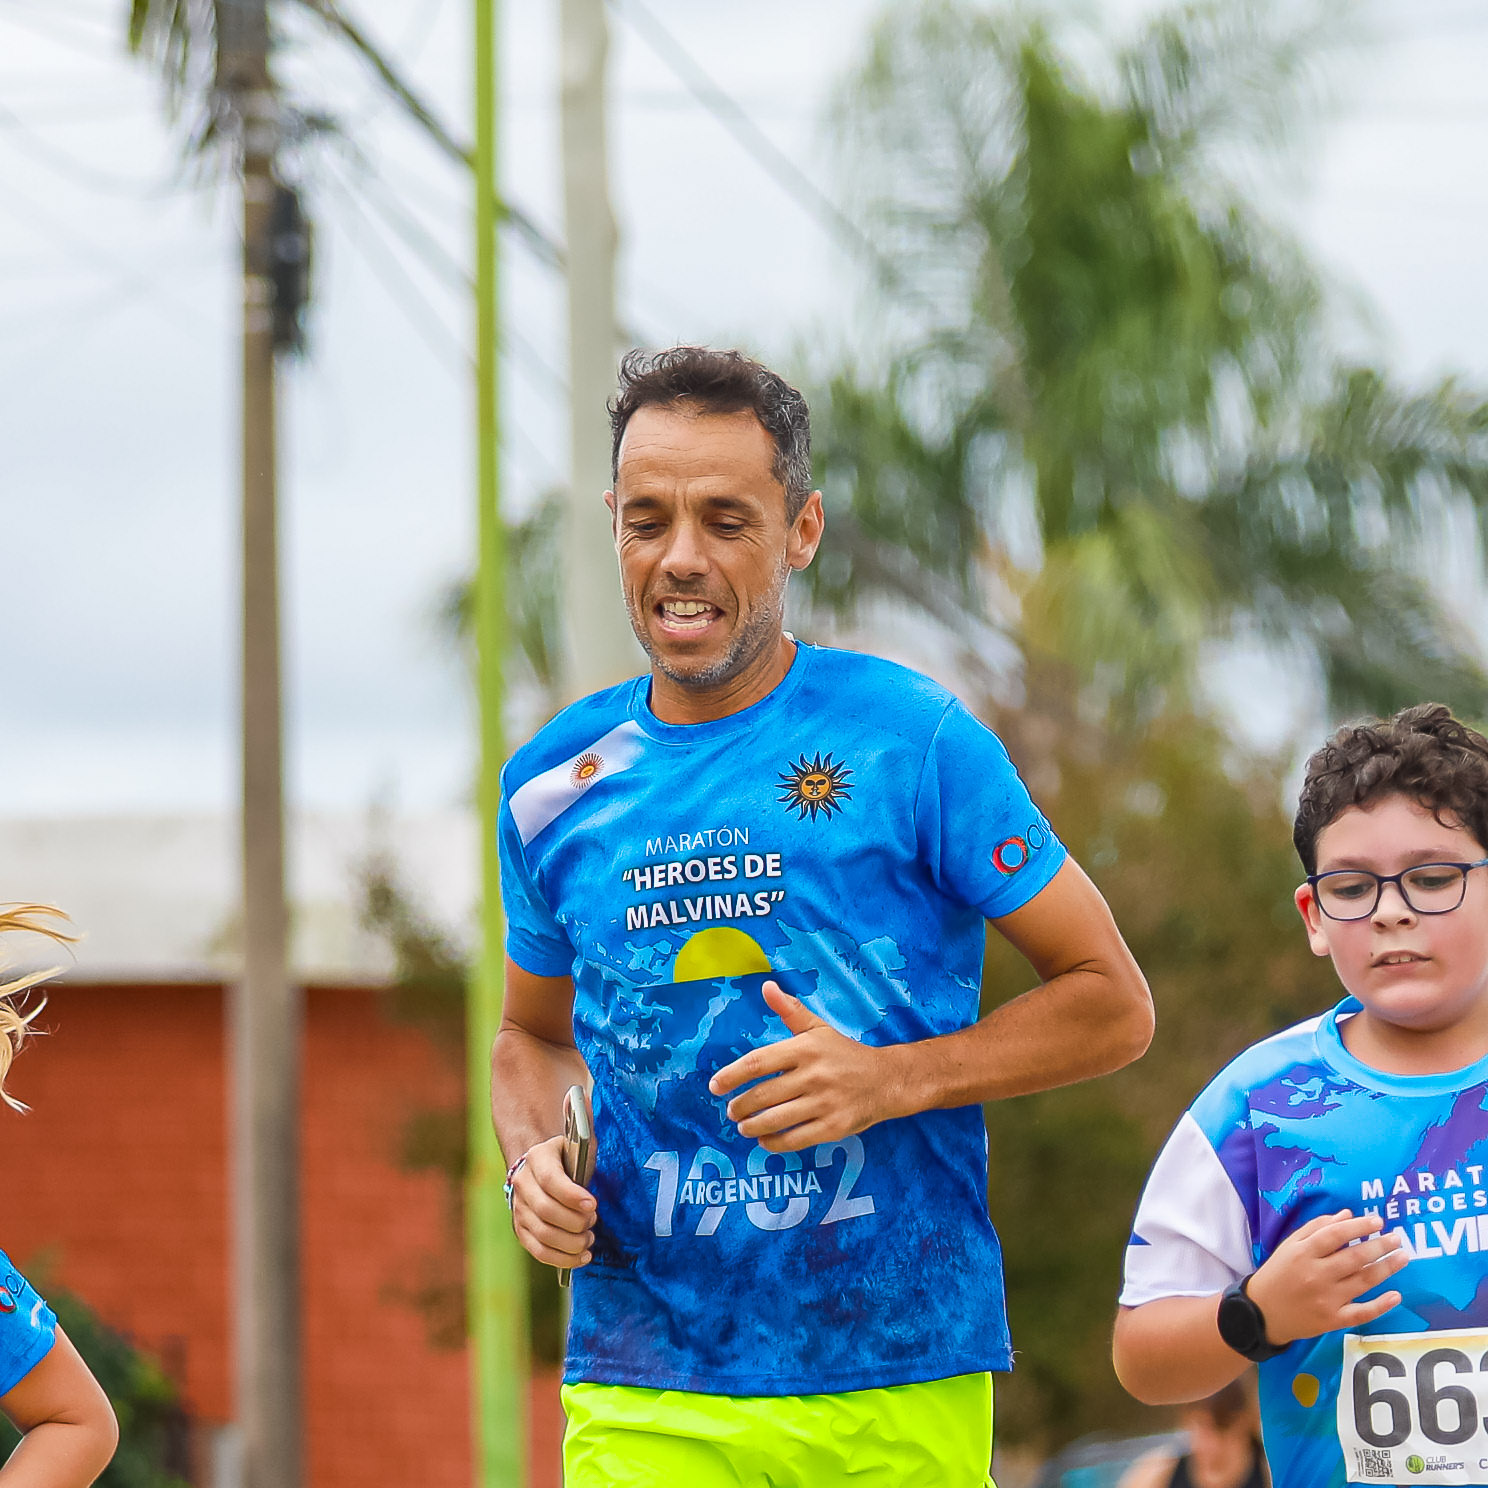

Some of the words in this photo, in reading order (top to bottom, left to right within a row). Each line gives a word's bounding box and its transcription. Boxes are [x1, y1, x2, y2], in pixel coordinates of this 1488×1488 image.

[645, 825, 749, 856] MARATÓN
[622, 855, 738, 892] “HEROES
[744, 853, 782, 878] DE
[626, 890, 785, 931] MALVINAS”
[643, 1135, 876, 1237] 1982
[678, 1171, 823, 1205] ARGENTINA
[1426, 1455, 1447, 1464] CLUB
